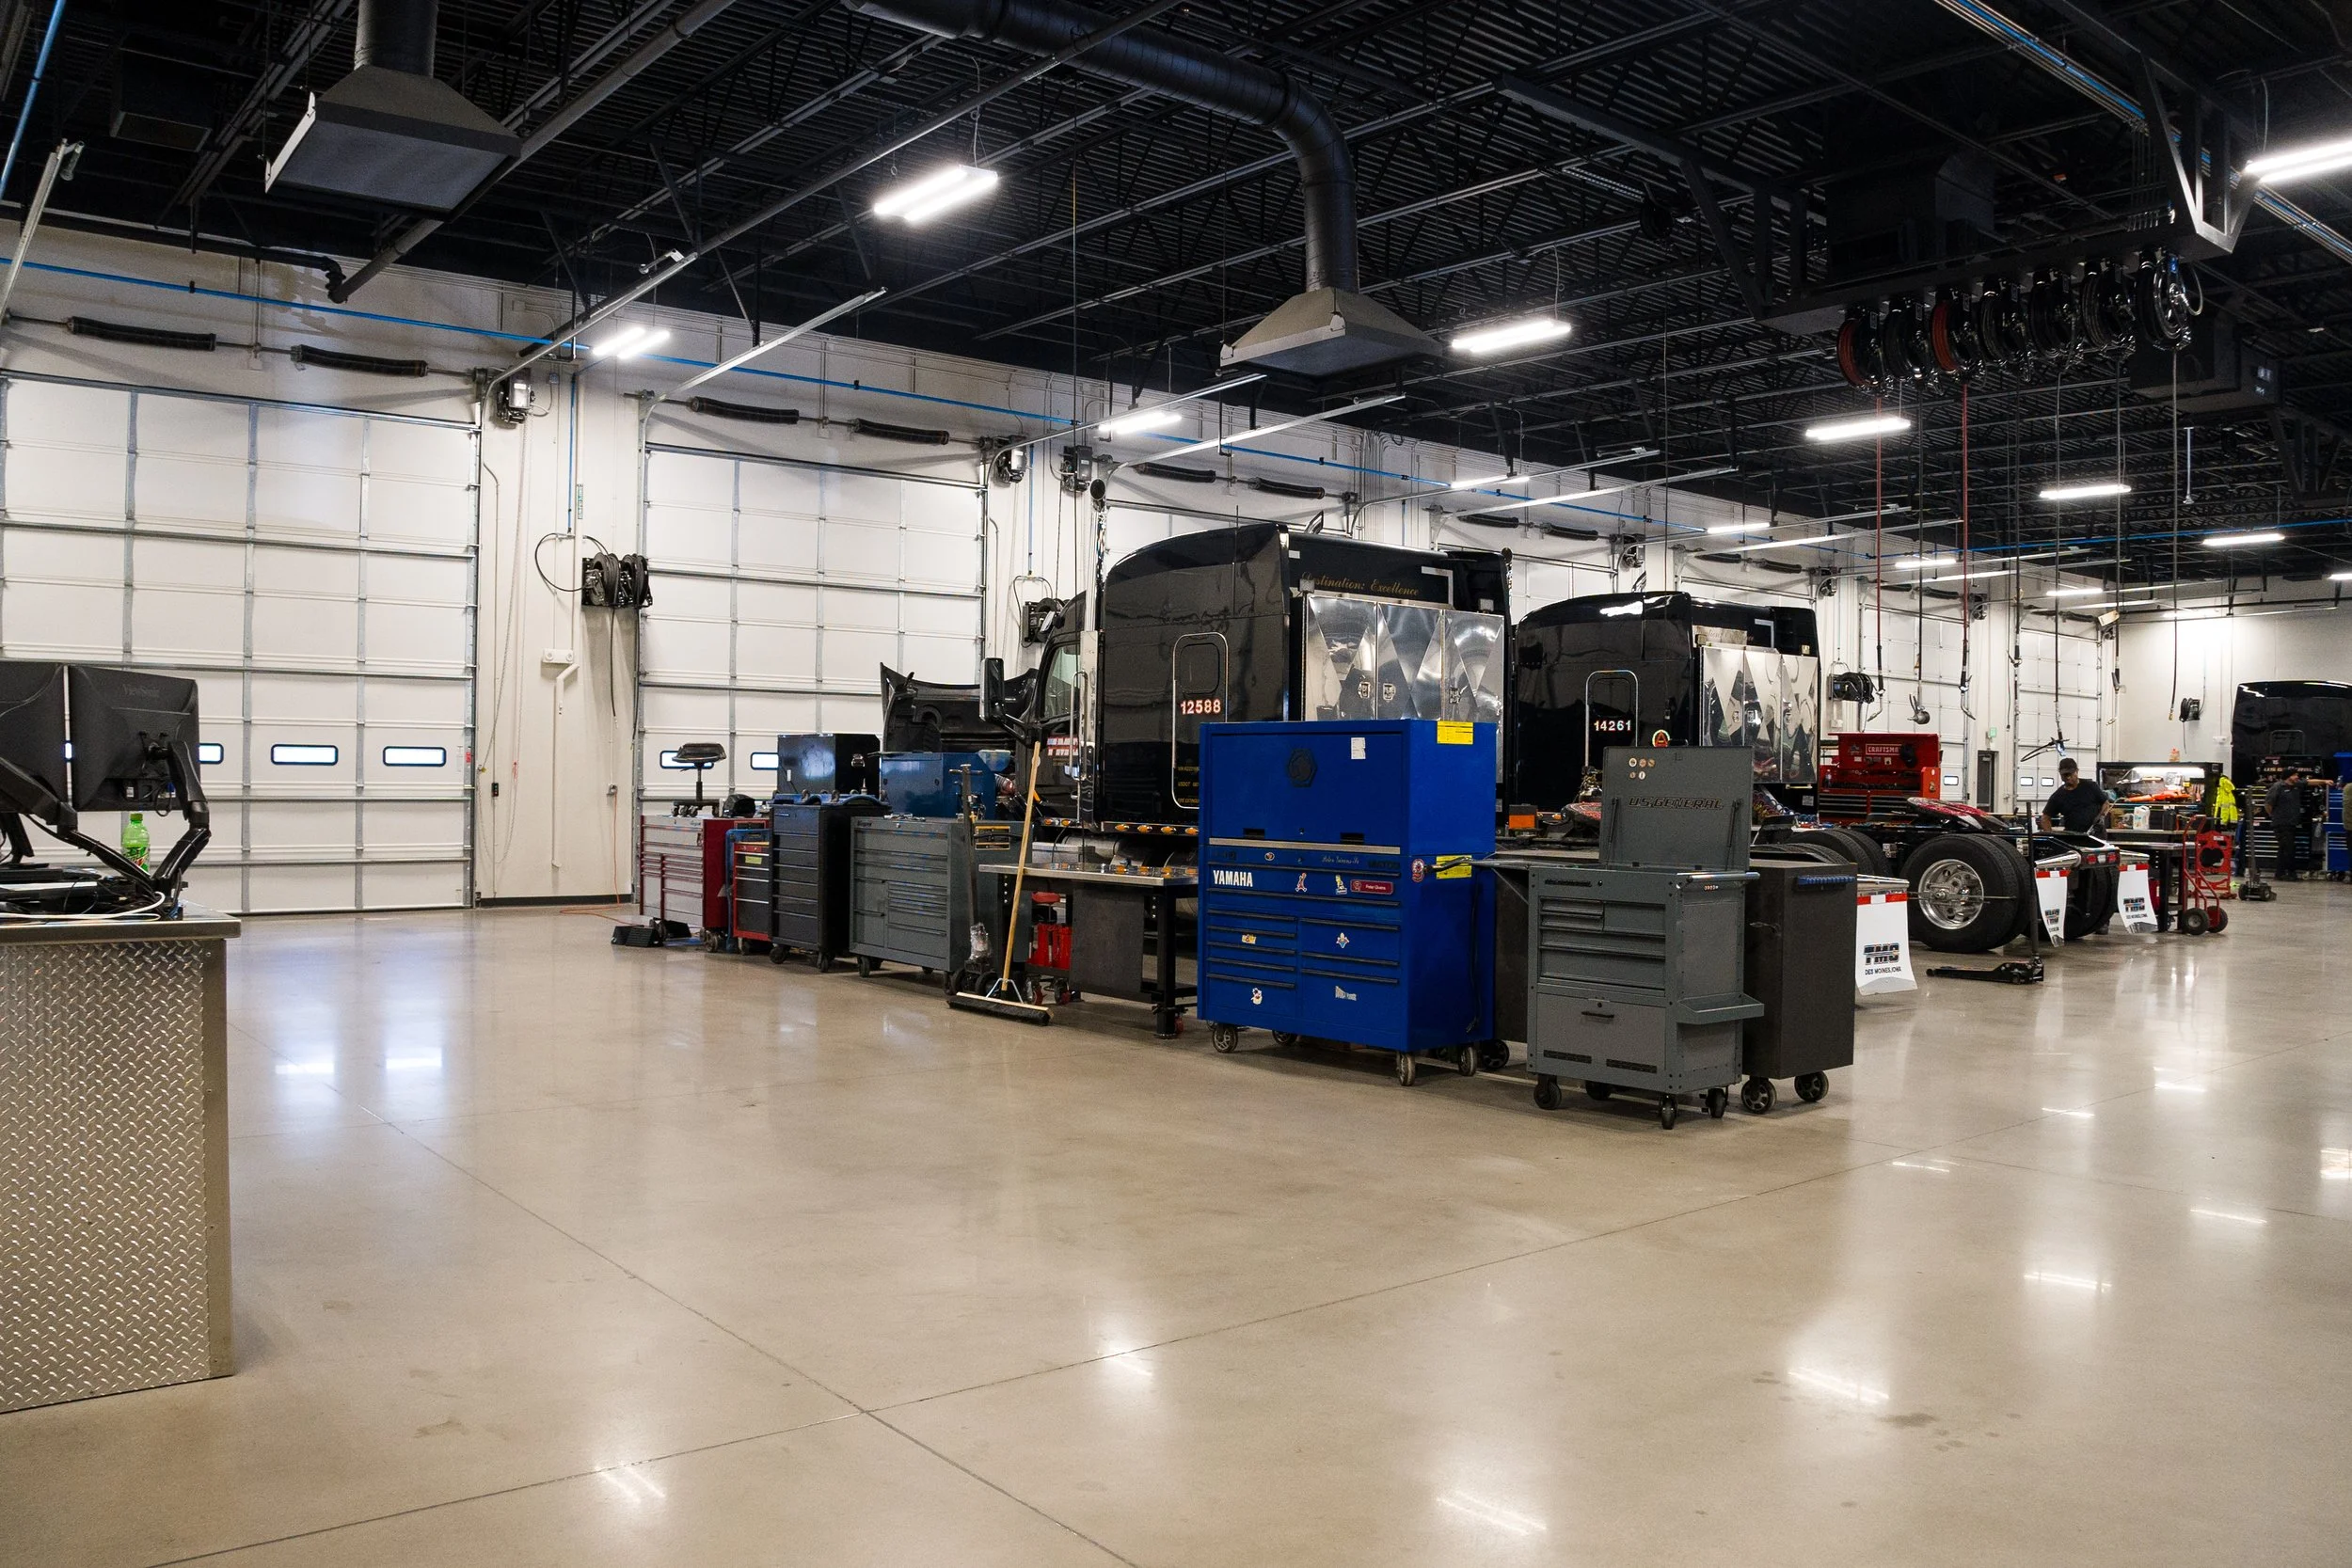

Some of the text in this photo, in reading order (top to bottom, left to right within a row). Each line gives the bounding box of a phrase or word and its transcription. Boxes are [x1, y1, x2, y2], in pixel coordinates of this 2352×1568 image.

[1302, 572, 1420, 596] stination: Excellence
[1181, 699, 1221, 715] 12588
[1594, 720, 1631, 732] 14261
[1213, 869, 1253, 887] YAMAHA
